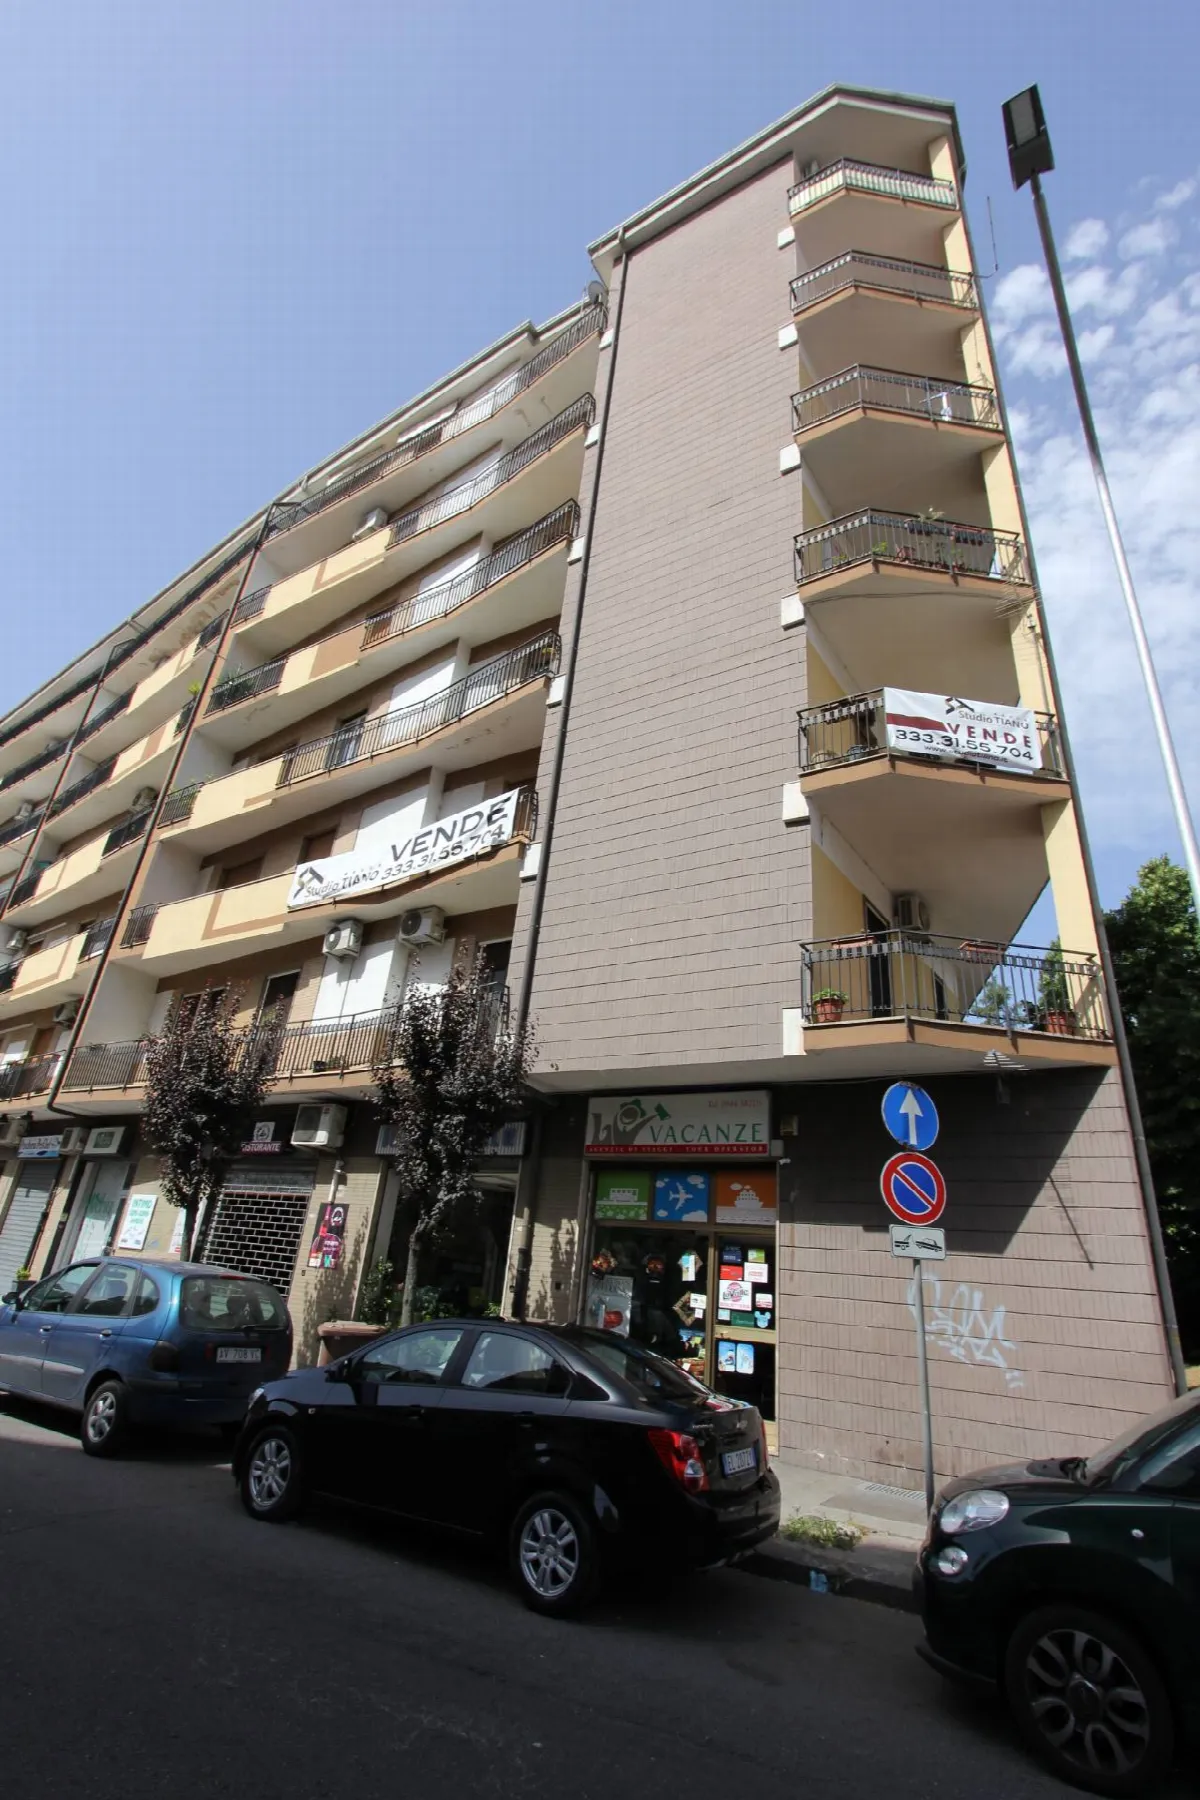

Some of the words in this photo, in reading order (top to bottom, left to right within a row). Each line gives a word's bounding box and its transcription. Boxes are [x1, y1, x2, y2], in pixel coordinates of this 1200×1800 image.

[958, 709, 993, 724] Studio
[993, 716, 1030, 730] TIANO
[895, 729, 1034, 761] 333.31.55.704
[946, 722, 1032, 748] VENDE
[390, 796, 512, 862] VENDE
[305, 881, 339, 898] Studio
[341, 869, 380, 890] TIANO
[380, 823, 506, 881] 333.31.55.704
[649, 1123, 763, 1143] VACANZE
